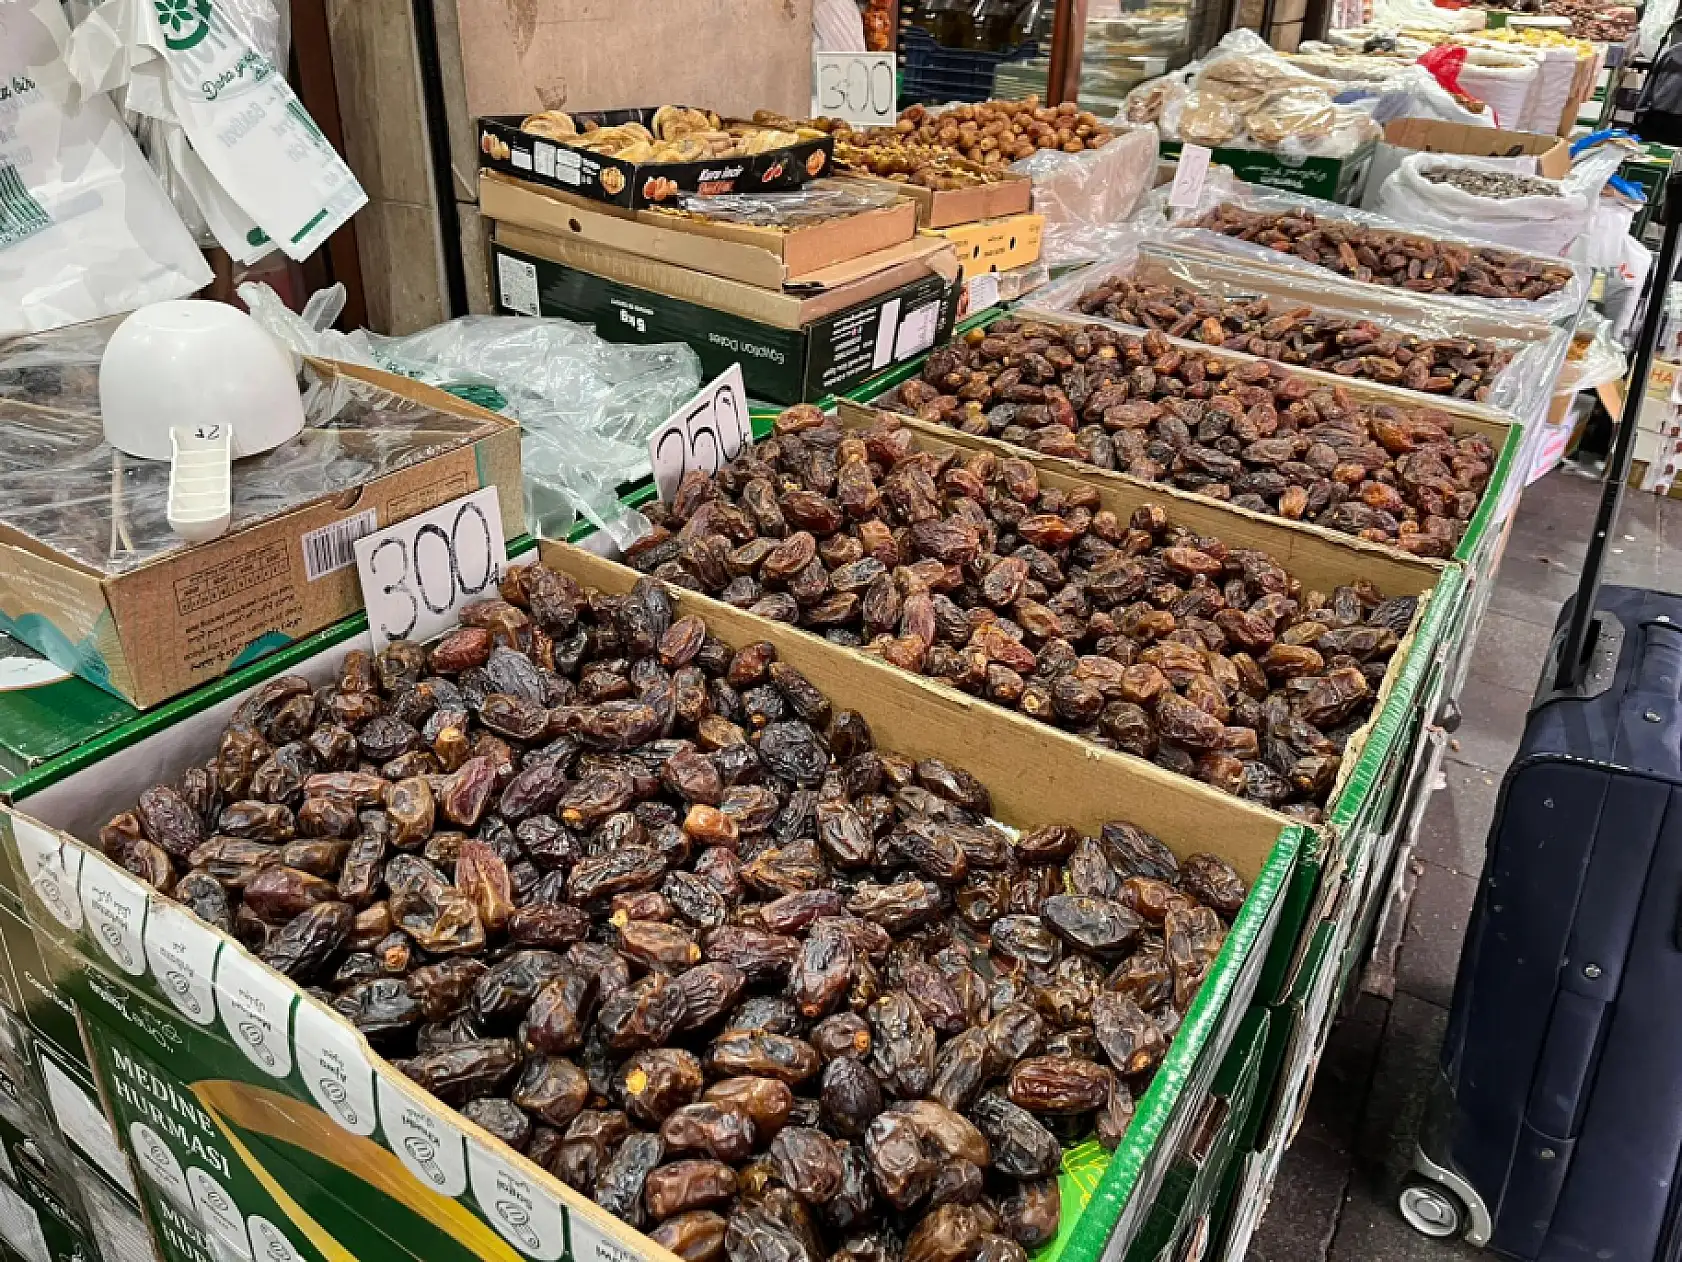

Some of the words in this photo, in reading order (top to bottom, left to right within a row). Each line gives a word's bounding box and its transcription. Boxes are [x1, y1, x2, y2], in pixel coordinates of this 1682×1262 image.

[820, 59, 893, 117] 300
[369, 501, 492, 641] 300
[111, 1046, 216, 1138] MEDİNE
[111, 1073, 233, 1180] HURMASI
